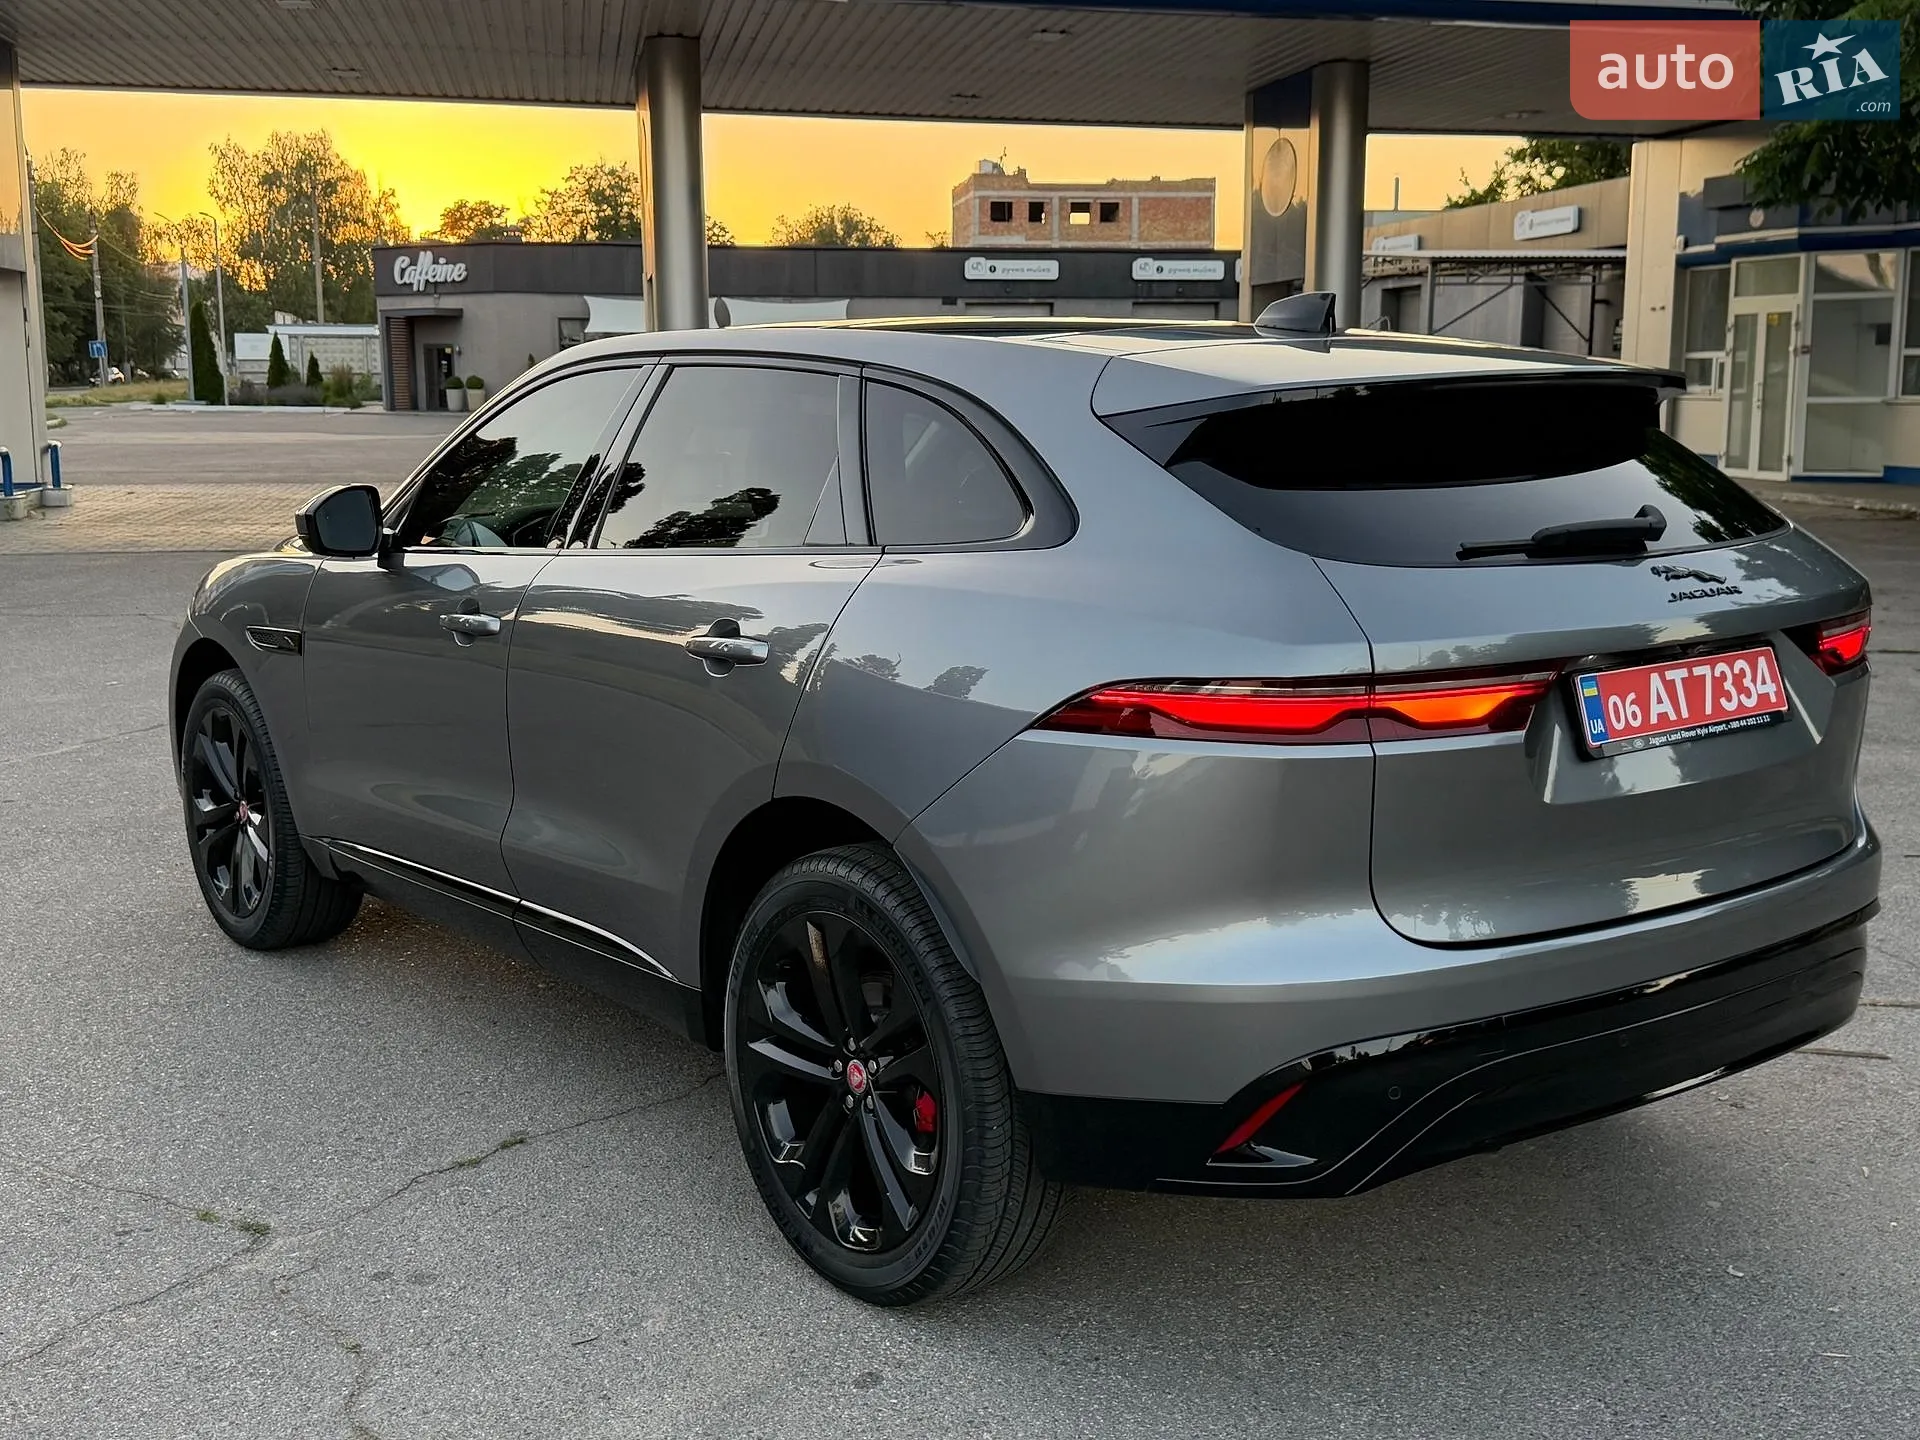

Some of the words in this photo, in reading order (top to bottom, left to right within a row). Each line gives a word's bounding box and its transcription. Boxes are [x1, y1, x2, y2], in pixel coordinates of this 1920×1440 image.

[393, 250, 468, 291] Caffeine
[1667, 585, 1743, 603] JAGUAR
[1608, 691, 1642, 731] 06
[1649, 668, 1689, 725] AT
[1693, 656, 1777, 716] 7334
[1590, 718, 1605, 734] UA
[1649, 736, 1667, 746] Jaguar
[1667, 731, 1681, 742] Land
